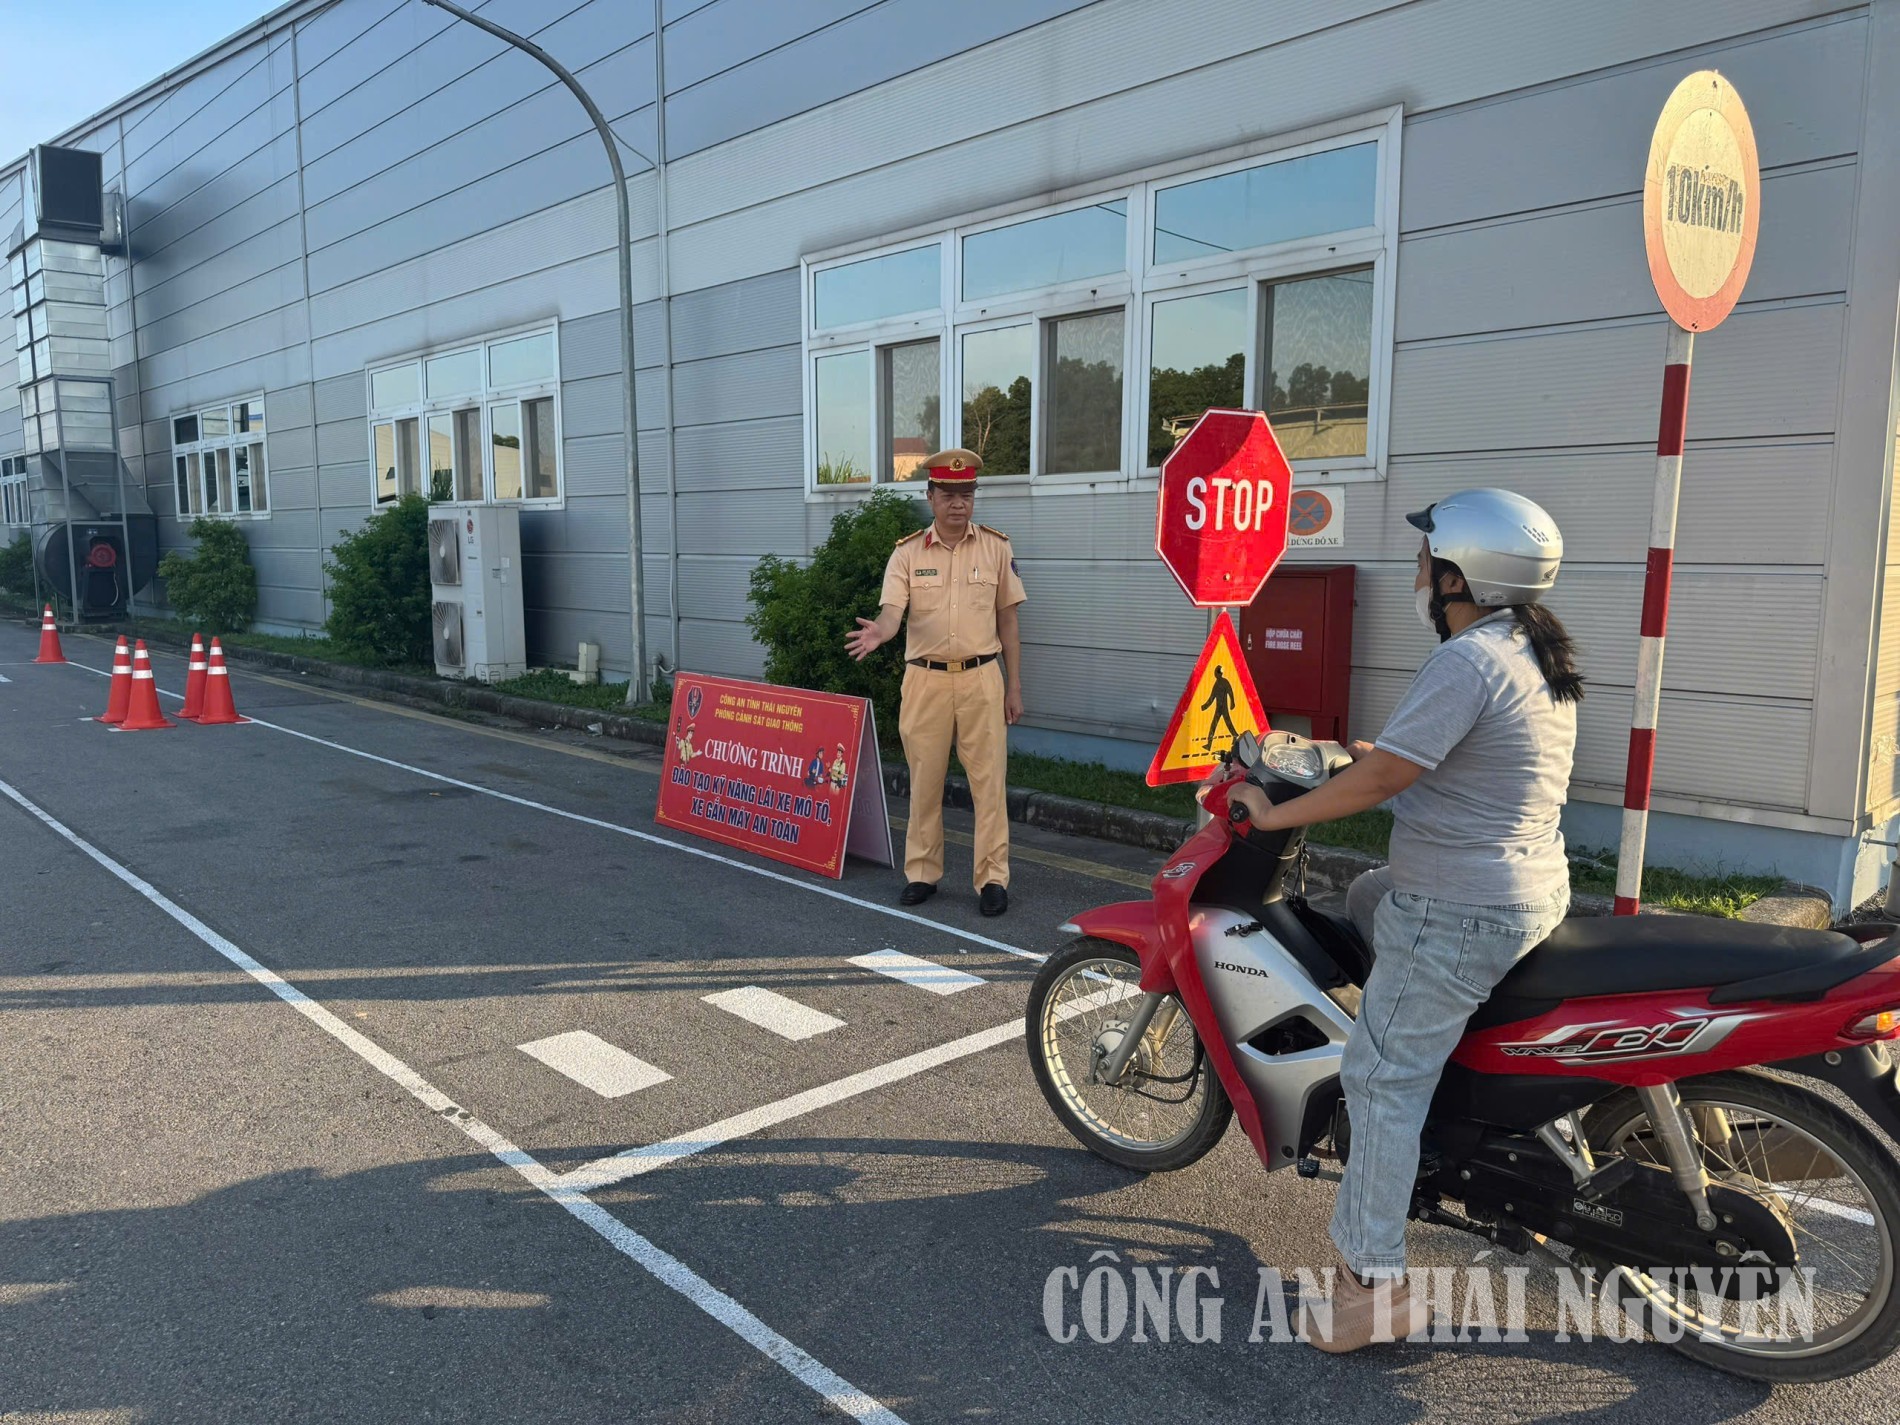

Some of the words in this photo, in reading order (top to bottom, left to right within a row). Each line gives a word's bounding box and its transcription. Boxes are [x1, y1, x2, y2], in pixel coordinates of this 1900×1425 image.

[1667, 165, 1743, 234] 10km/h
[1185, 476, 1274, 532] STOP
[1328, 537, 1339, 545] XE
[714, 707, 735, 721] PHÒNG
[752, 714, 766, 726] SÁT
[765, 717, 781, 729] GIAO
[781, 719, 803, 733] THÔNG
[719, 693, 736, 706] CÔNG
[736, 697, 746, 708] AN
[761, 699, 776, 713] THÁI
[776, 703, 803, 717] NGUYÊN
[704, 738, 758, 769] CHƯƠNG
[760, 747, 804, 779] TRÌNH
[672, 764, 692, 786] ĐÀO
[692, 771, 710, 794] TẠO
[711, 774, 727, 796] KỸ
[726, 777, 756, 805] NĂNG
[757, 785, 775, 809] LÁI
[776, 791, 793, 813] XE
[793, 795, 813, 818] MÔ
[815, 799, 832, 826] TÔ,
[690, 796, 704, 816] XE
[705, 797, 727, 823] GẮN
[727, 806, 751, 830] MÁY
[752, 815, 769, 835] AN
[770, 818, 801, 844] TOÀN
[1213, 960, 1270, 979] HONDA
